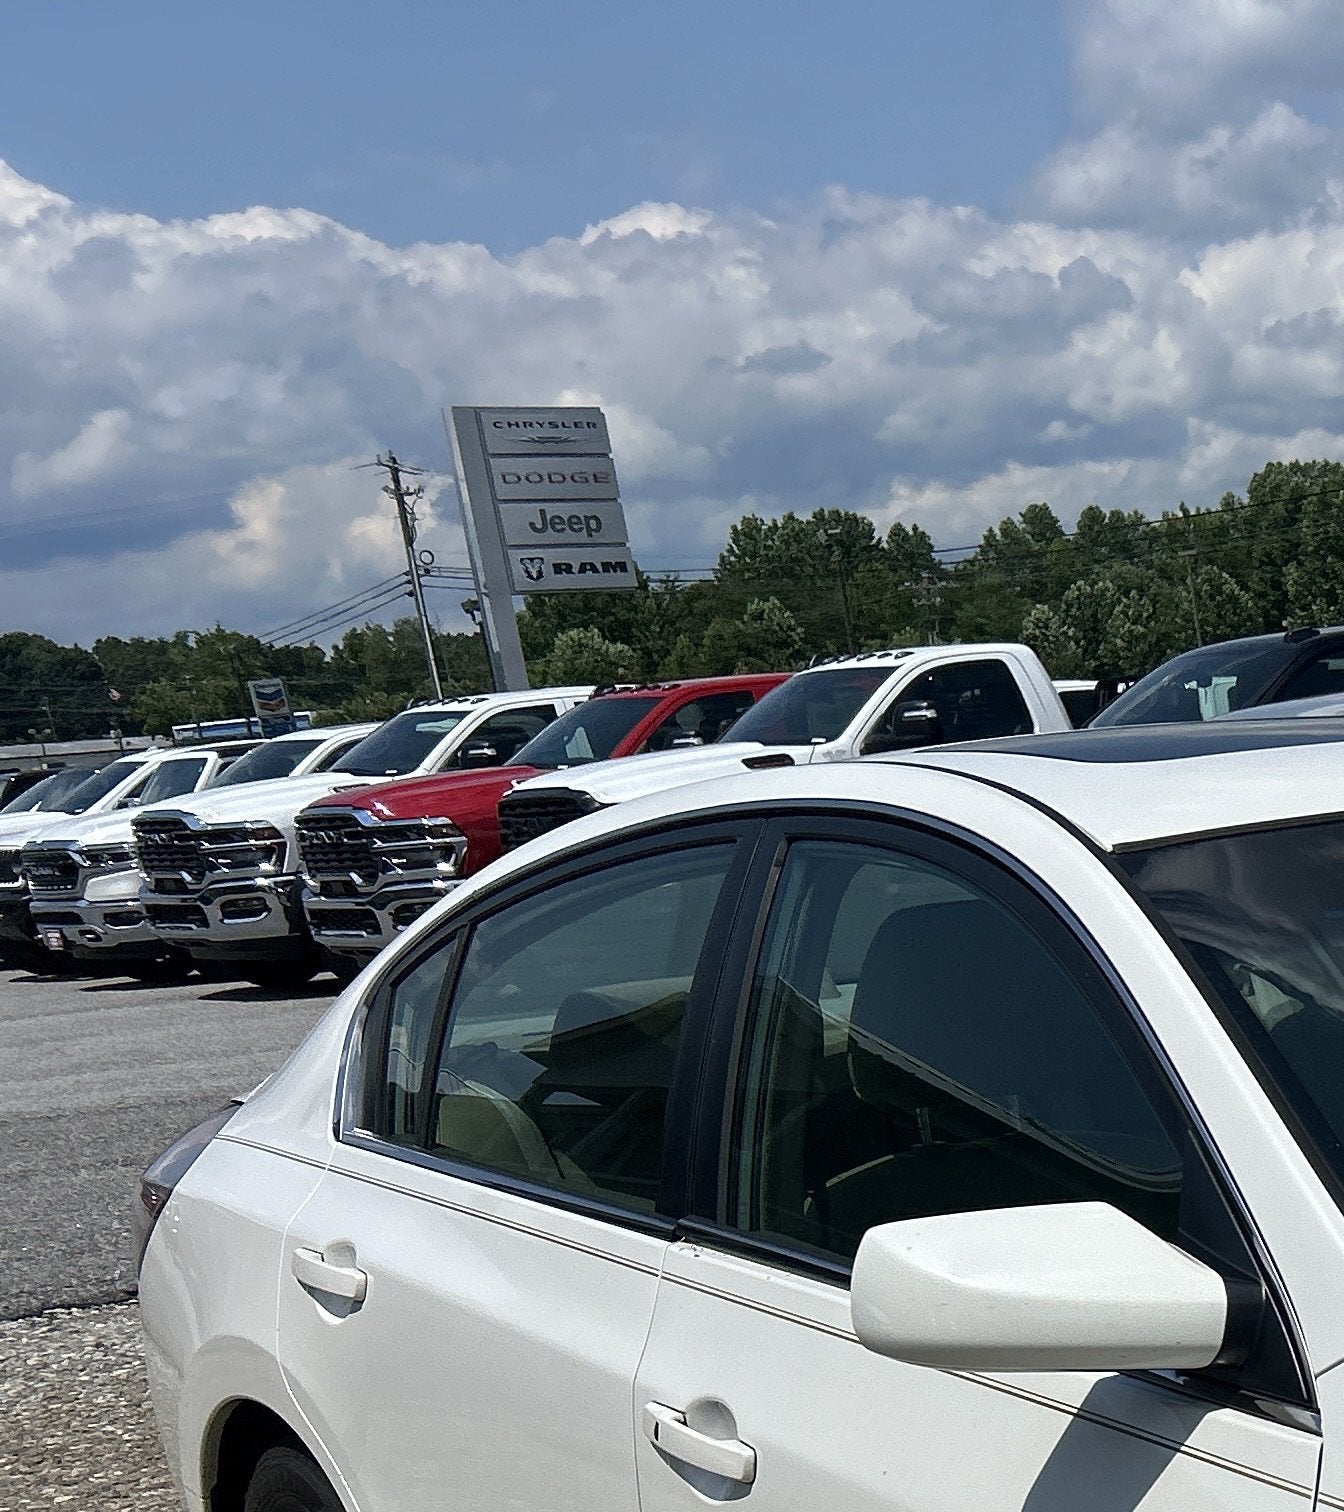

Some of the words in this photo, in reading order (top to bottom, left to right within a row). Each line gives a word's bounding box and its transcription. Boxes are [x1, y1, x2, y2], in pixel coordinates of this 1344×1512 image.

[492, 420, 598, 430] CHRYSLER
[501, 471, 611, 485] DODGE
[528, 508, 603, 538] Jeep
[551, 560, 629, 575] RAM
